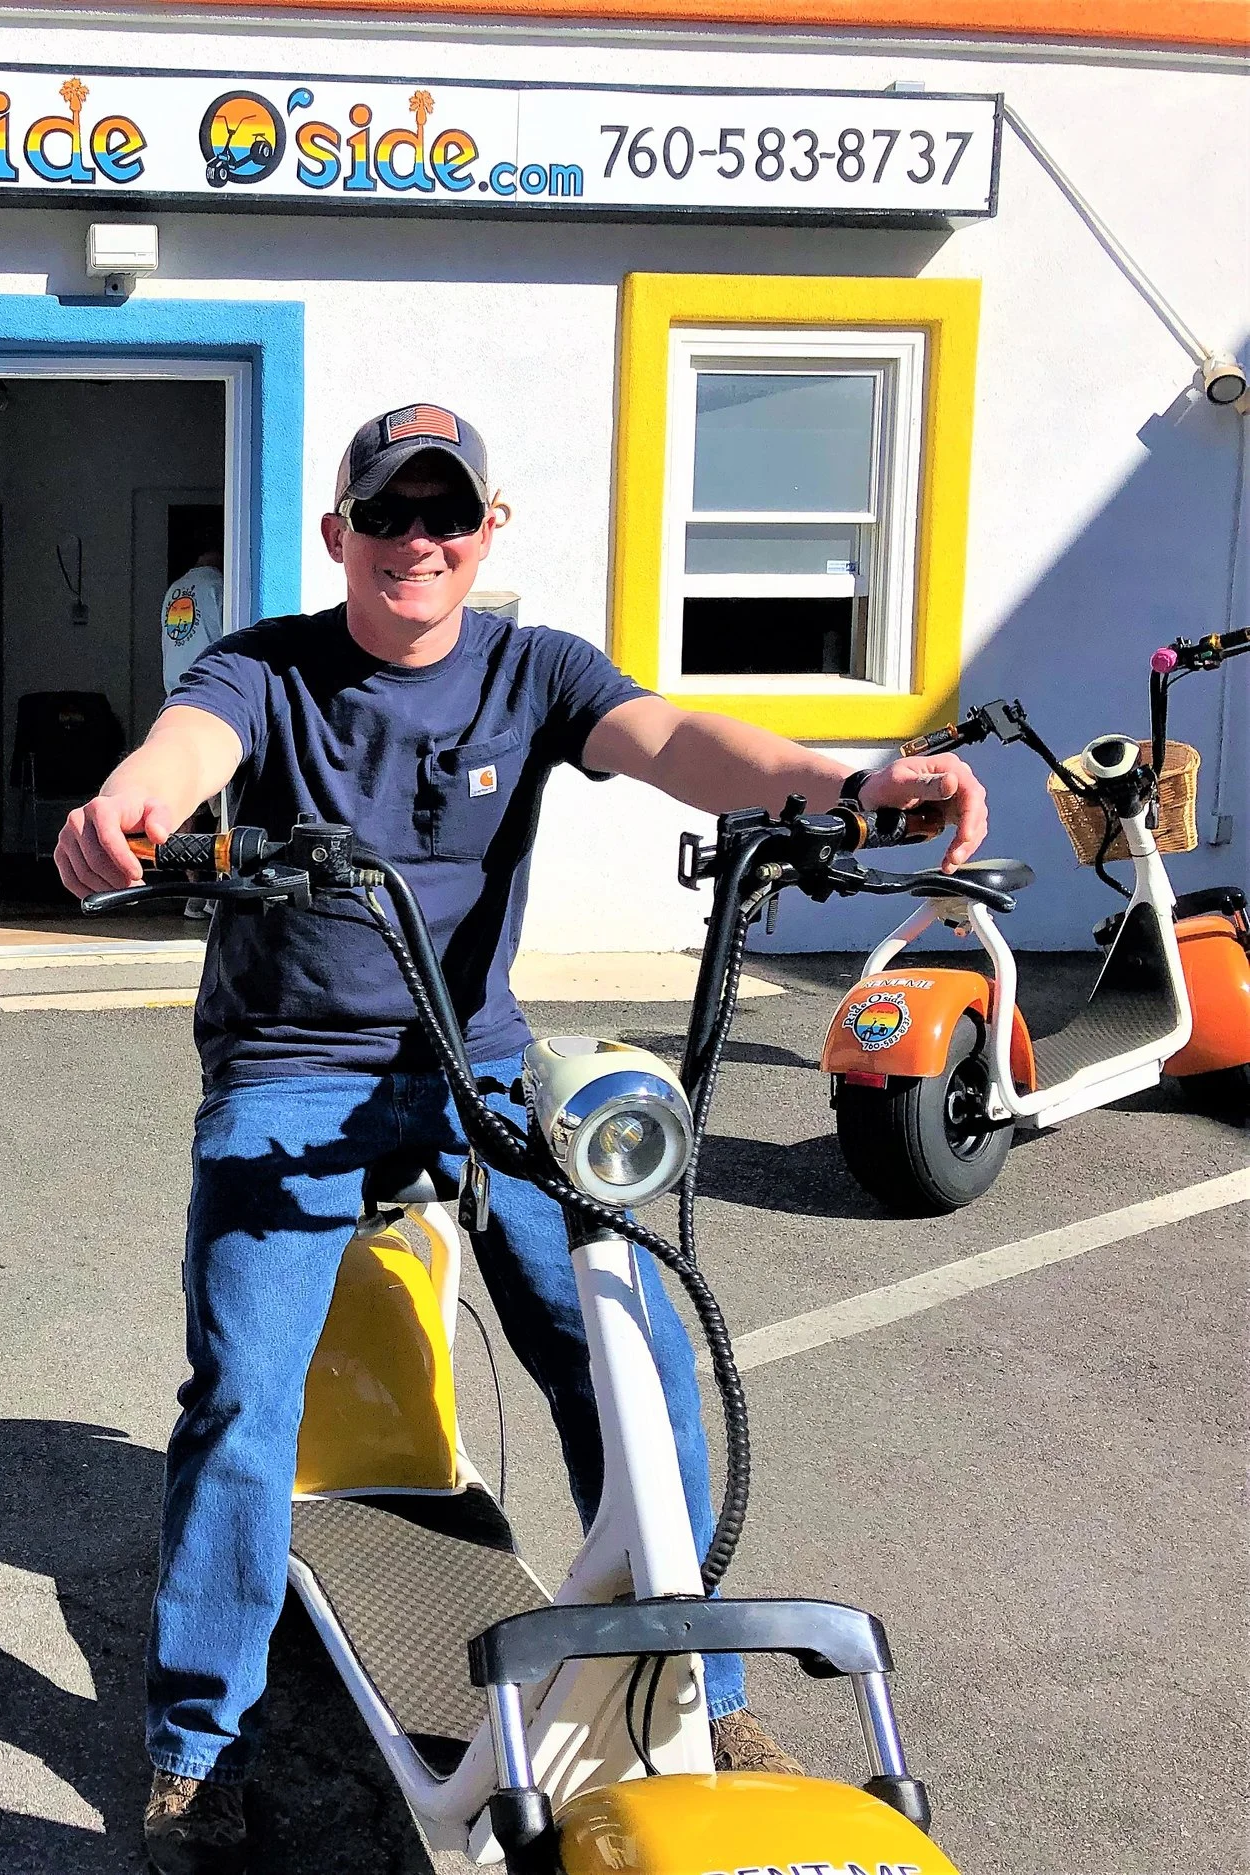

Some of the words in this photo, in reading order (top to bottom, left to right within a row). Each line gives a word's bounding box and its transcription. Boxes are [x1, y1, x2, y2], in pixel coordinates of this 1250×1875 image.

[599, 124, 974, 187] 760-583-8737
[843, 1004, 867, 1029] Ride
[863, 1017, 910, 1050] 760-583-8737
